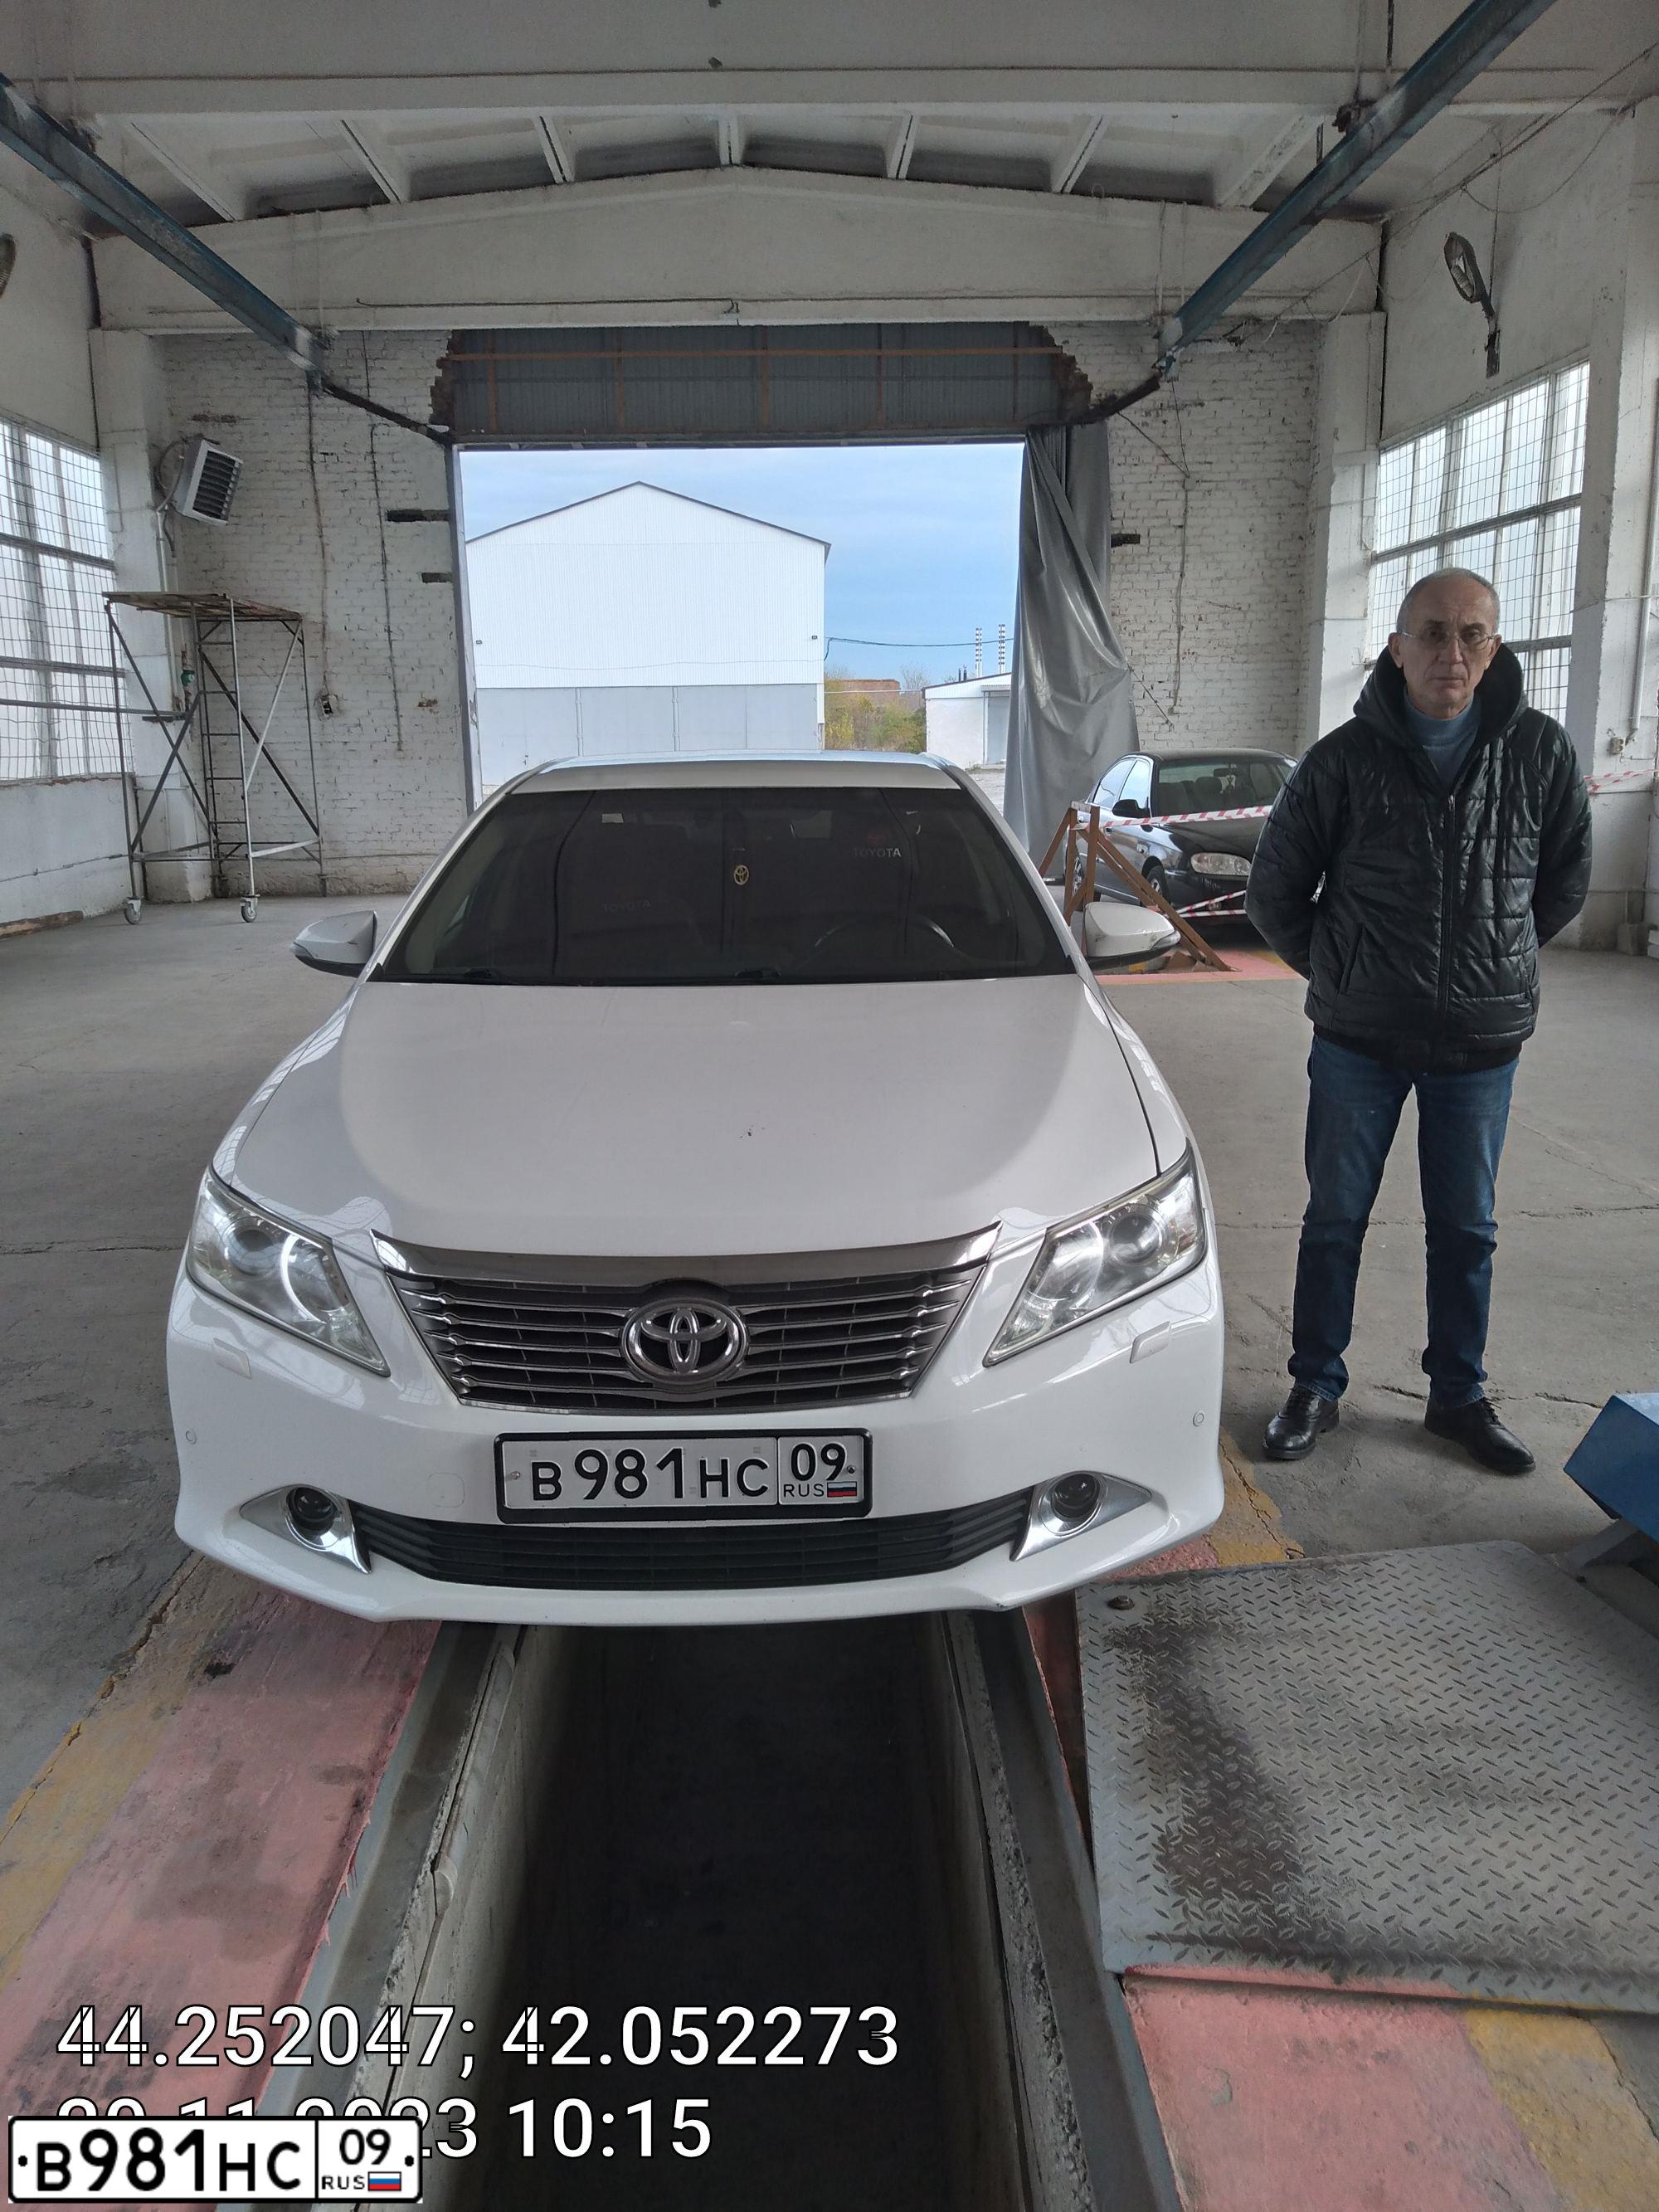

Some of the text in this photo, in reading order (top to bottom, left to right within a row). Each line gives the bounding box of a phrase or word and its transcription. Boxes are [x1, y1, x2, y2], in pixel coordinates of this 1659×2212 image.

[851, 847, 902, 857] TOYOTA
[791, 1442, 847, 1482] 09
[783, 1483, 825, 1498] RUS
